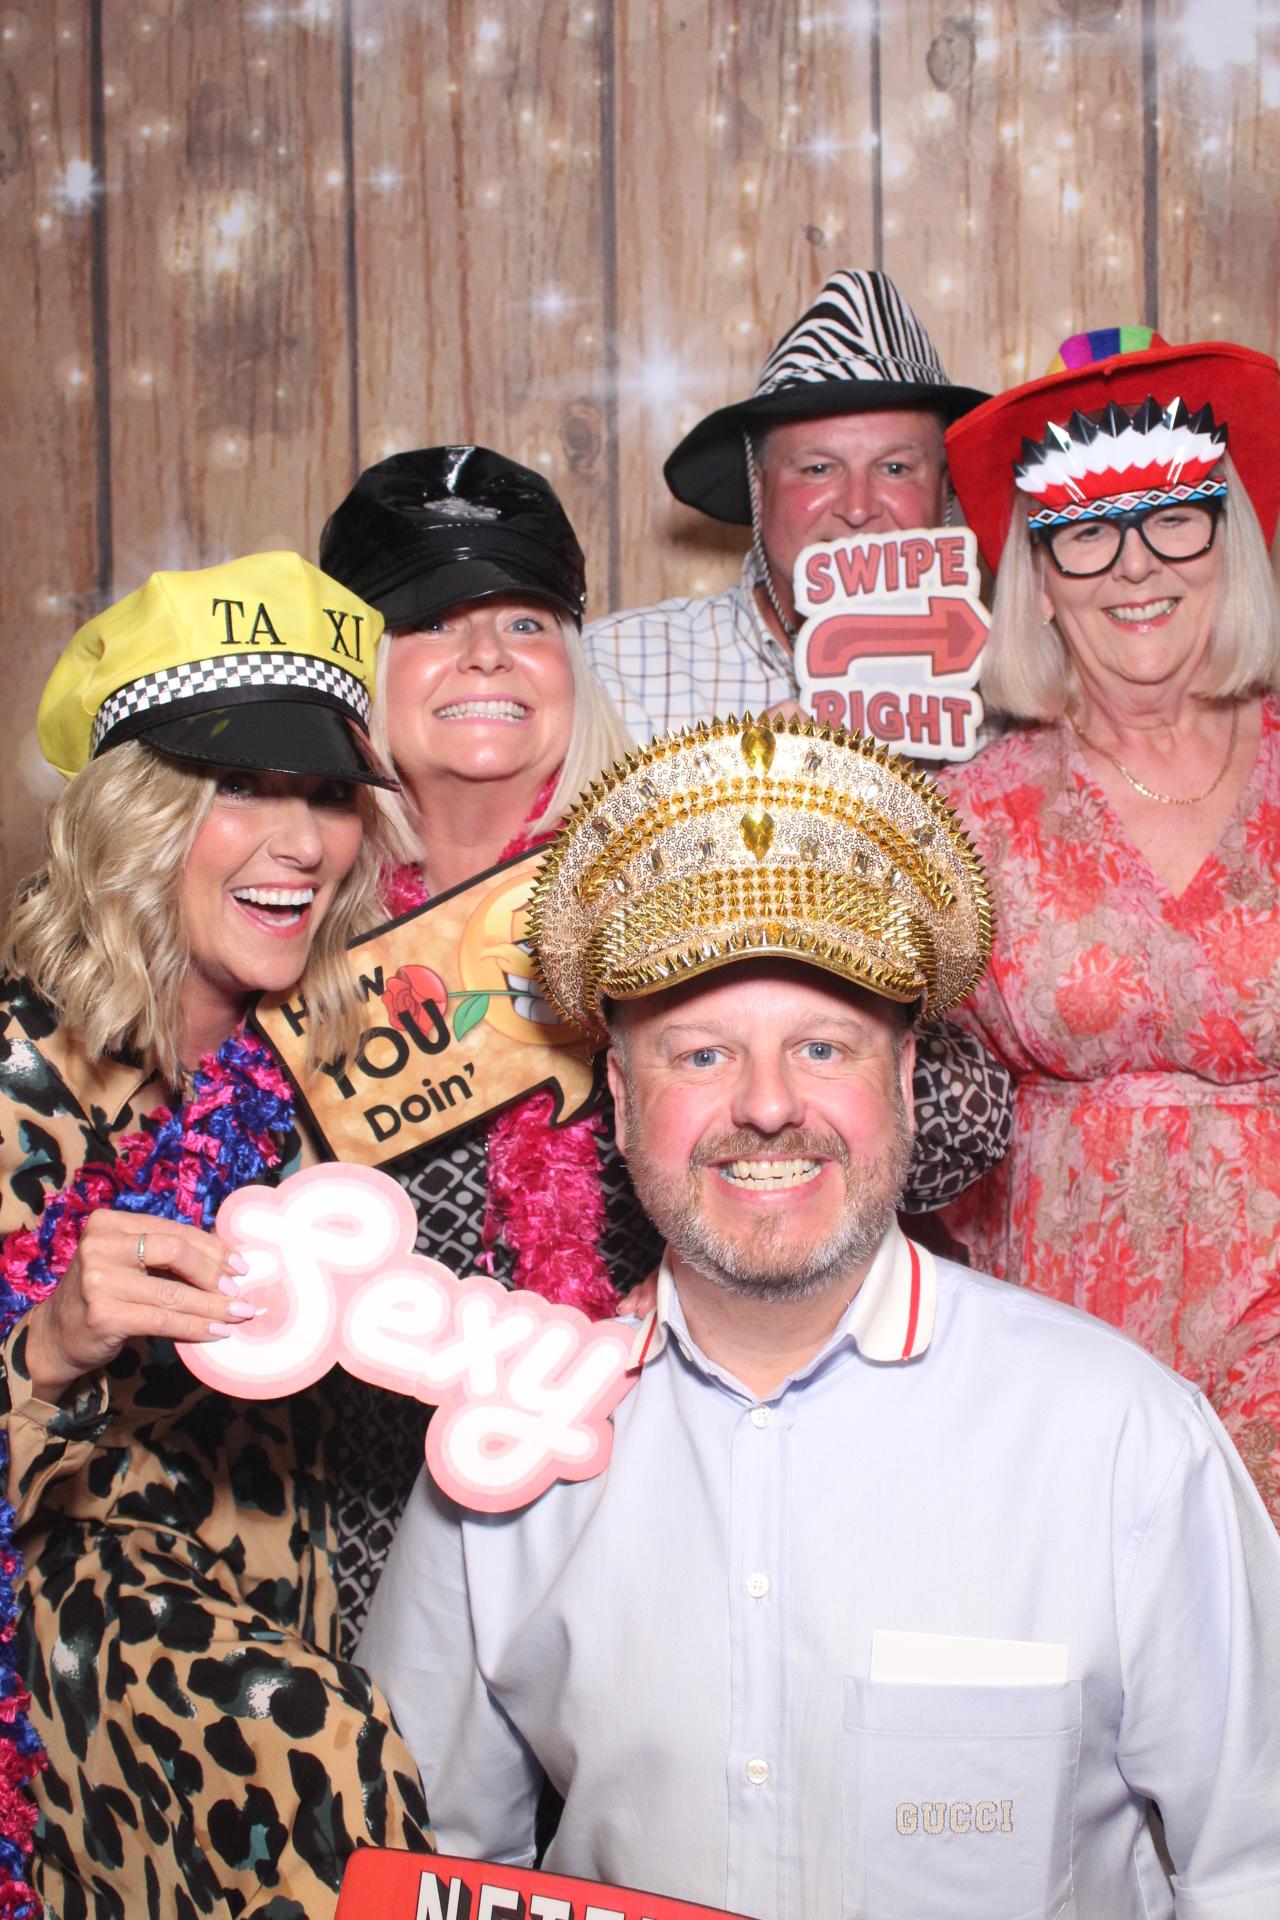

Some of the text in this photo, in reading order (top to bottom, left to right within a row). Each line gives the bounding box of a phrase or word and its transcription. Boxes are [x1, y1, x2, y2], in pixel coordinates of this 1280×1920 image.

[805, 536, 969, 605] SWIPE
[811, 690, 972, 748] RIGHT
[280, 965, 385, 1037] HW
[313, 997, 451, 1100] YOU
[193, 1181, 624, 1491] Sexy
[896, 1799, 1013, 1836] GUCCI
